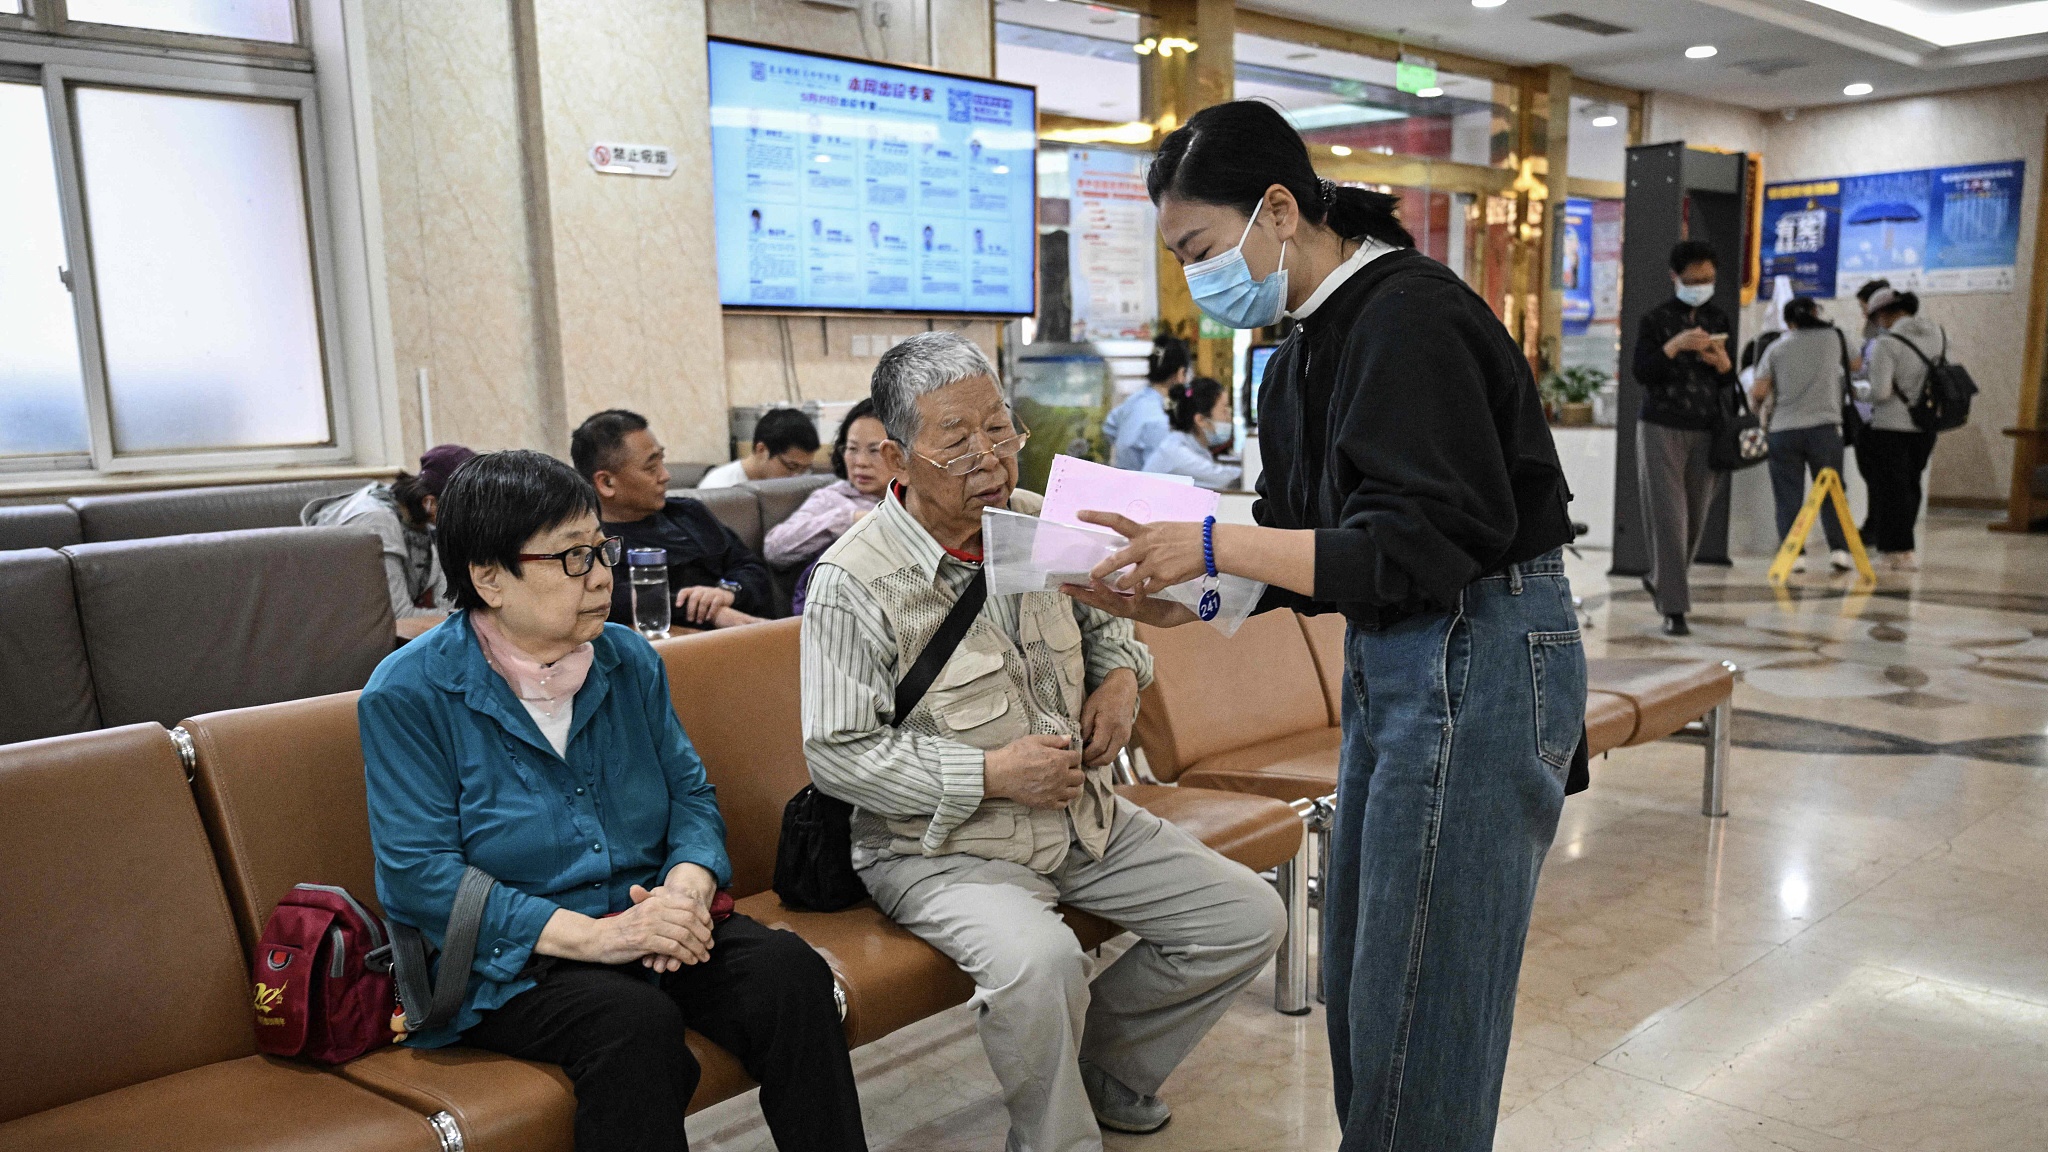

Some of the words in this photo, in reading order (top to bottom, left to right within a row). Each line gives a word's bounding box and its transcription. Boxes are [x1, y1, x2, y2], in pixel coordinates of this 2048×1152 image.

[613, 147, 668, 164] 禁止吸烟
[1200, 596, 1218, 618] 241
